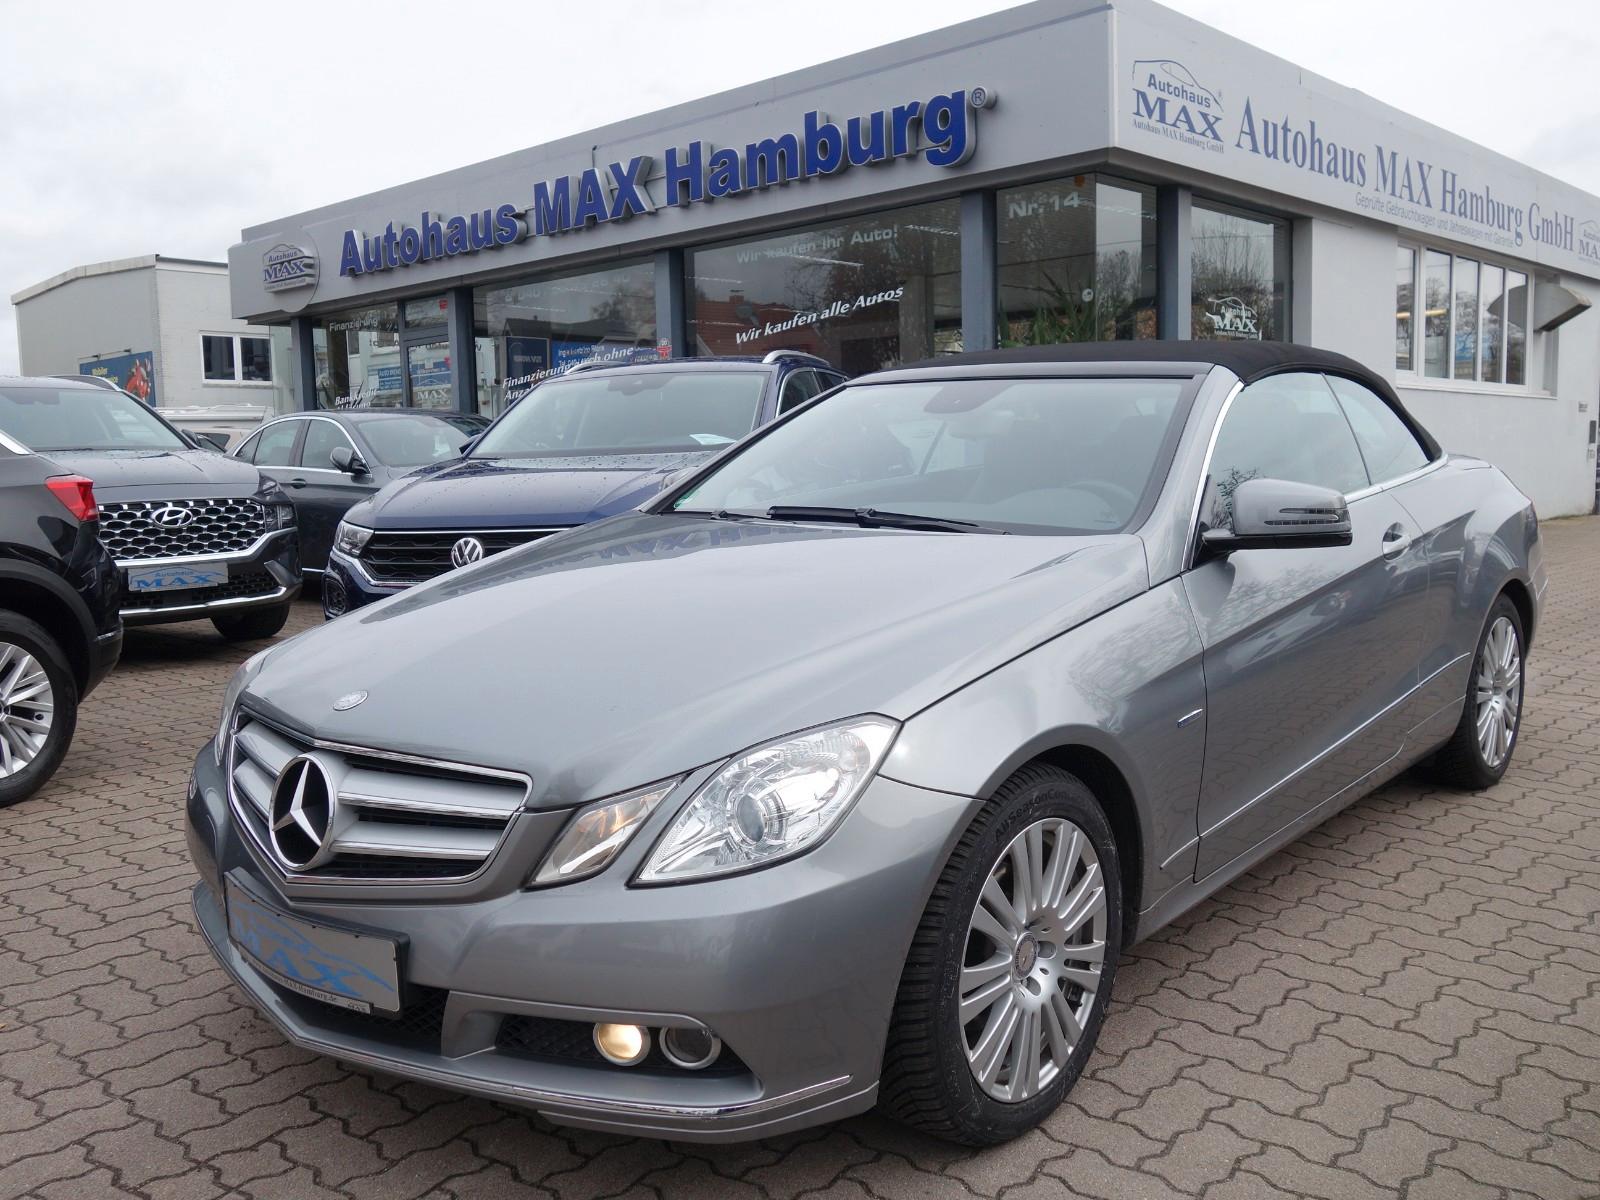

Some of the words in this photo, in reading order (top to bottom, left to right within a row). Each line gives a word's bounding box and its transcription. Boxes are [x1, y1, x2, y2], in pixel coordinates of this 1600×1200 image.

[1148, 73, 1211, 108] Autohaus
[1132, 88, 1224, 142] MAX
[1161, 126, 1178, 140] MAX
[1179, 132, 1206, 151] Hamburg
[339, 203, 519, 277] Autohaus
[533, 156, 647, 236] MAX
[664, 89, 968, 207] Hamburg
[1235, 96, 1367, 189] Autohaus
[1374, 144, 1433, 208] MAX
[1440, 168, 1524, 247] Hamburg
[1528, 203, 1575, 251] GmbH
[1049, 191, 1079, 211] 14
[1355, 191, 1385, 213] Geprüfte
[736, 249, 761, 265] Wir
[766, 241, 817, 258] kaufen
[851, 224, 898, 245] Auto!
[263, 260, 306, 281] MAX
[735, 328, 762, 344] Wir
[763, 312, 817, 336] kaufen
[820, 300, 850, 319] alle
[852, 286, 904, 311] Autos
[1213, 314, 1258, 333] MAX
[604, 347, 634, 361] ohne
[134, 574, 216, 590] MAX
